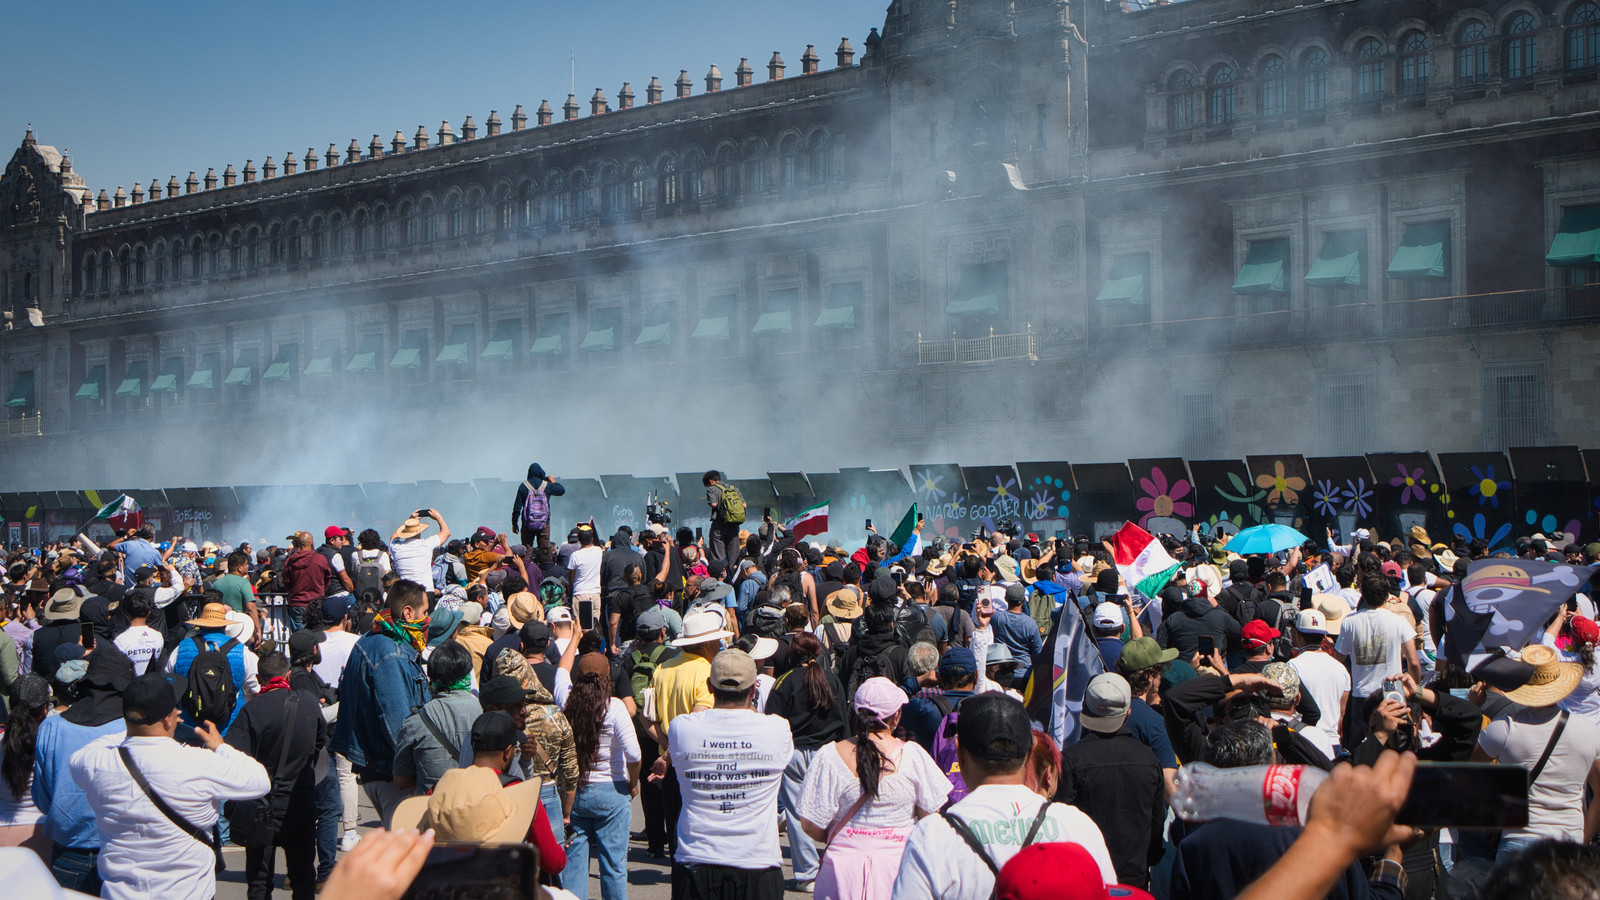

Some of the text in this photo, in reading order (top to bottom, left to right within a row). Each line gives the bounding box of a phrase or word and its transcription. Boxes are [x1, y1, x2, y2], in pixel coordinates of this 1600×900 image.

[703, 740, 752, 749] i went to
[684, 751, 773, 761] yankee stadium
[716, 762, 737, 771] and
[685, 770, 770, 782] all i got was this
[692, 781, 762, 790] eric emanuel
[711, 792, 746, 800] t-shirt
